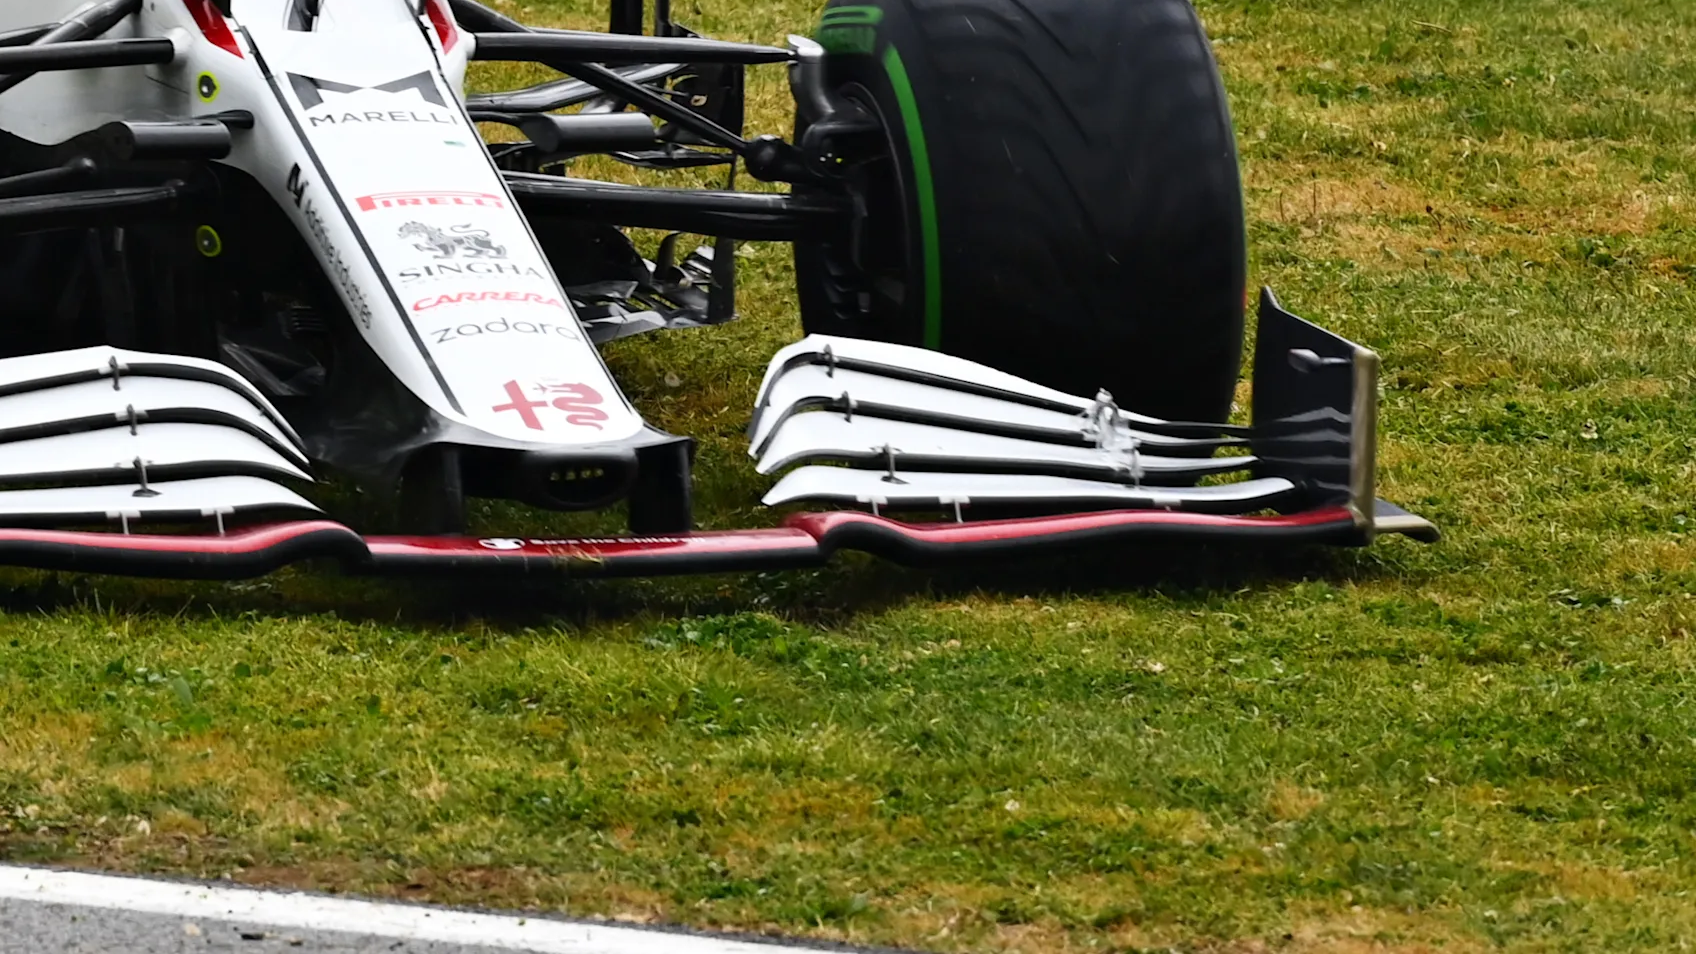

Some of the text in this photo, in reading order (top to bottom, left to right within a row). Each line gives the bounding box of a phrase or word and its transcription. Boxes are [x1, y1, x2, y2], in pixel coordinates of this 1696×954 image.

[308, 110, 458, 127] MARELLI
[354, 190, 504, 212] PIRELLI
[398, 262, 545, 283] SINGHA
[412, 291, 565, 312] CARRERA
[430, 317, 583, 344] zadara
